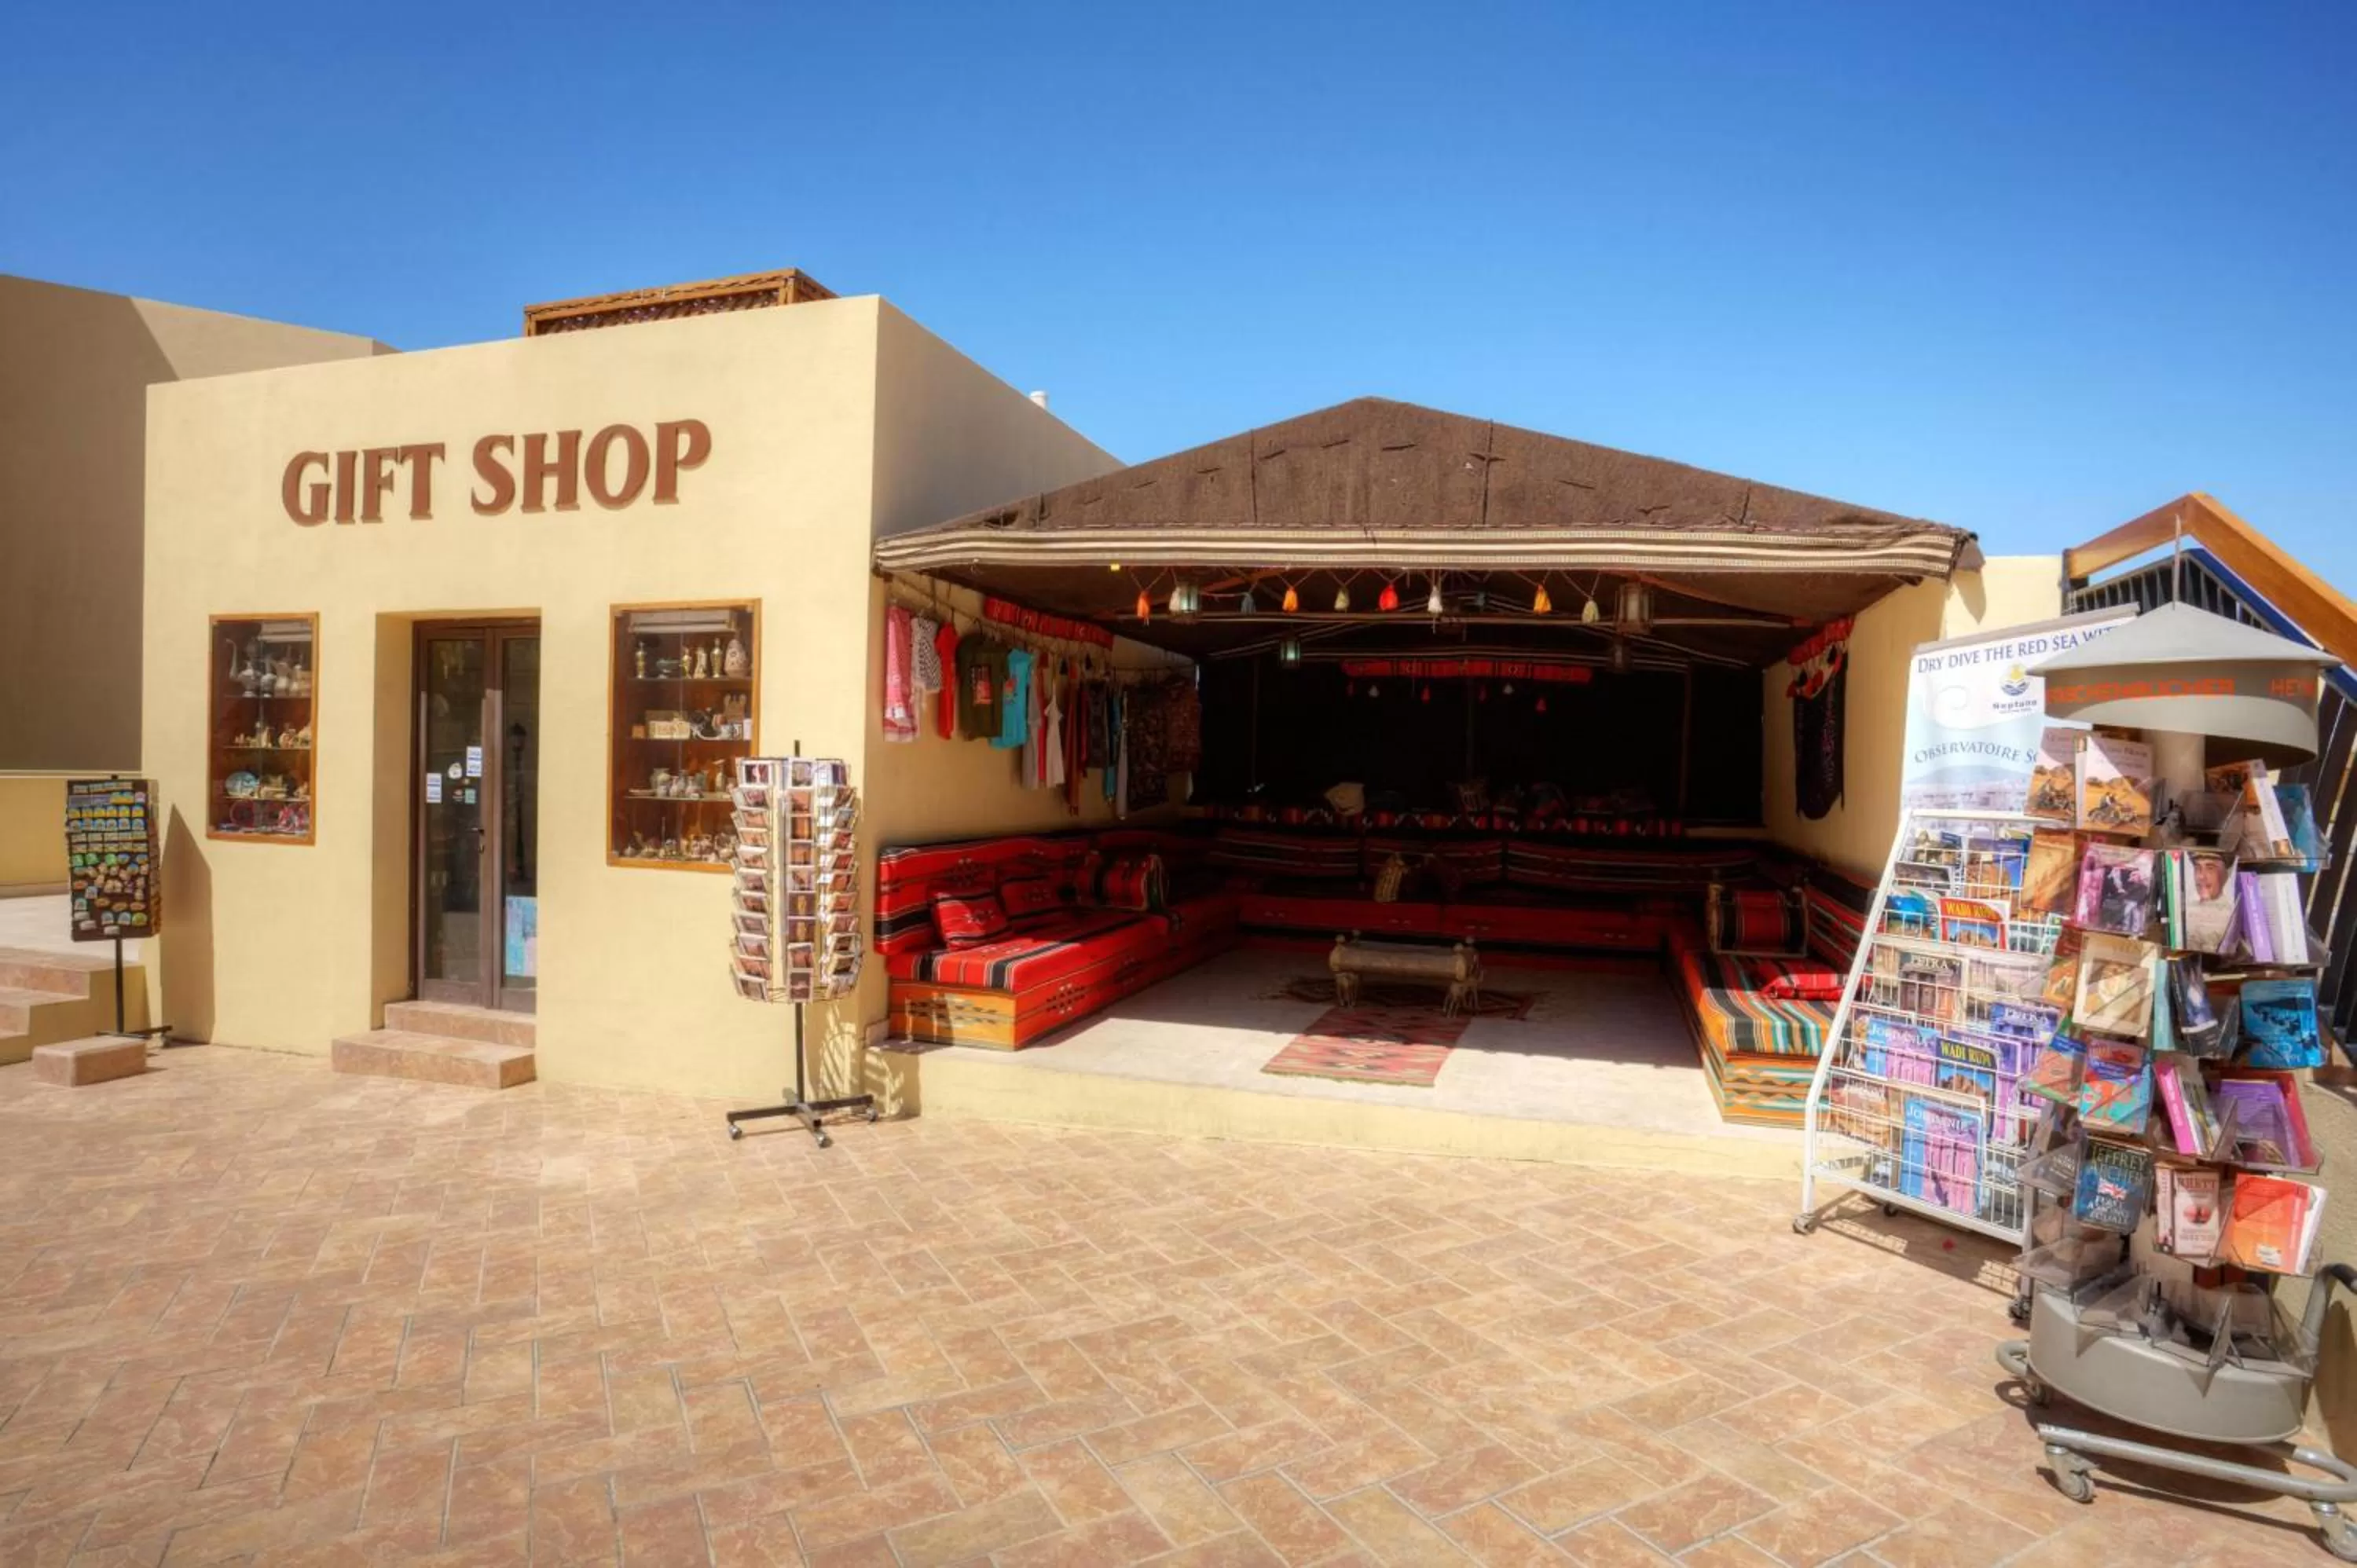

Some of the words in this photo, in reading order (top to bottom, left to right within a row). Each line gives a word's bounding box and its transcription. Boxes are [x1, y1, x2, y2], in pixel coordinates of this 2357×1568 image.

[282, 442, 445, 527] GIFT
[471, 419, 712, 516] SHOP
[1918, 656, 1945, 673] DRY
[1948, 650, 1980, 668] DIVE
[1985, 645, 2013, 661] THE
[2018, 639, 2047, 657] RED
[2052, 634, 2079, 651] SEA
[1941, 1041, 1966, 1060] WADI
